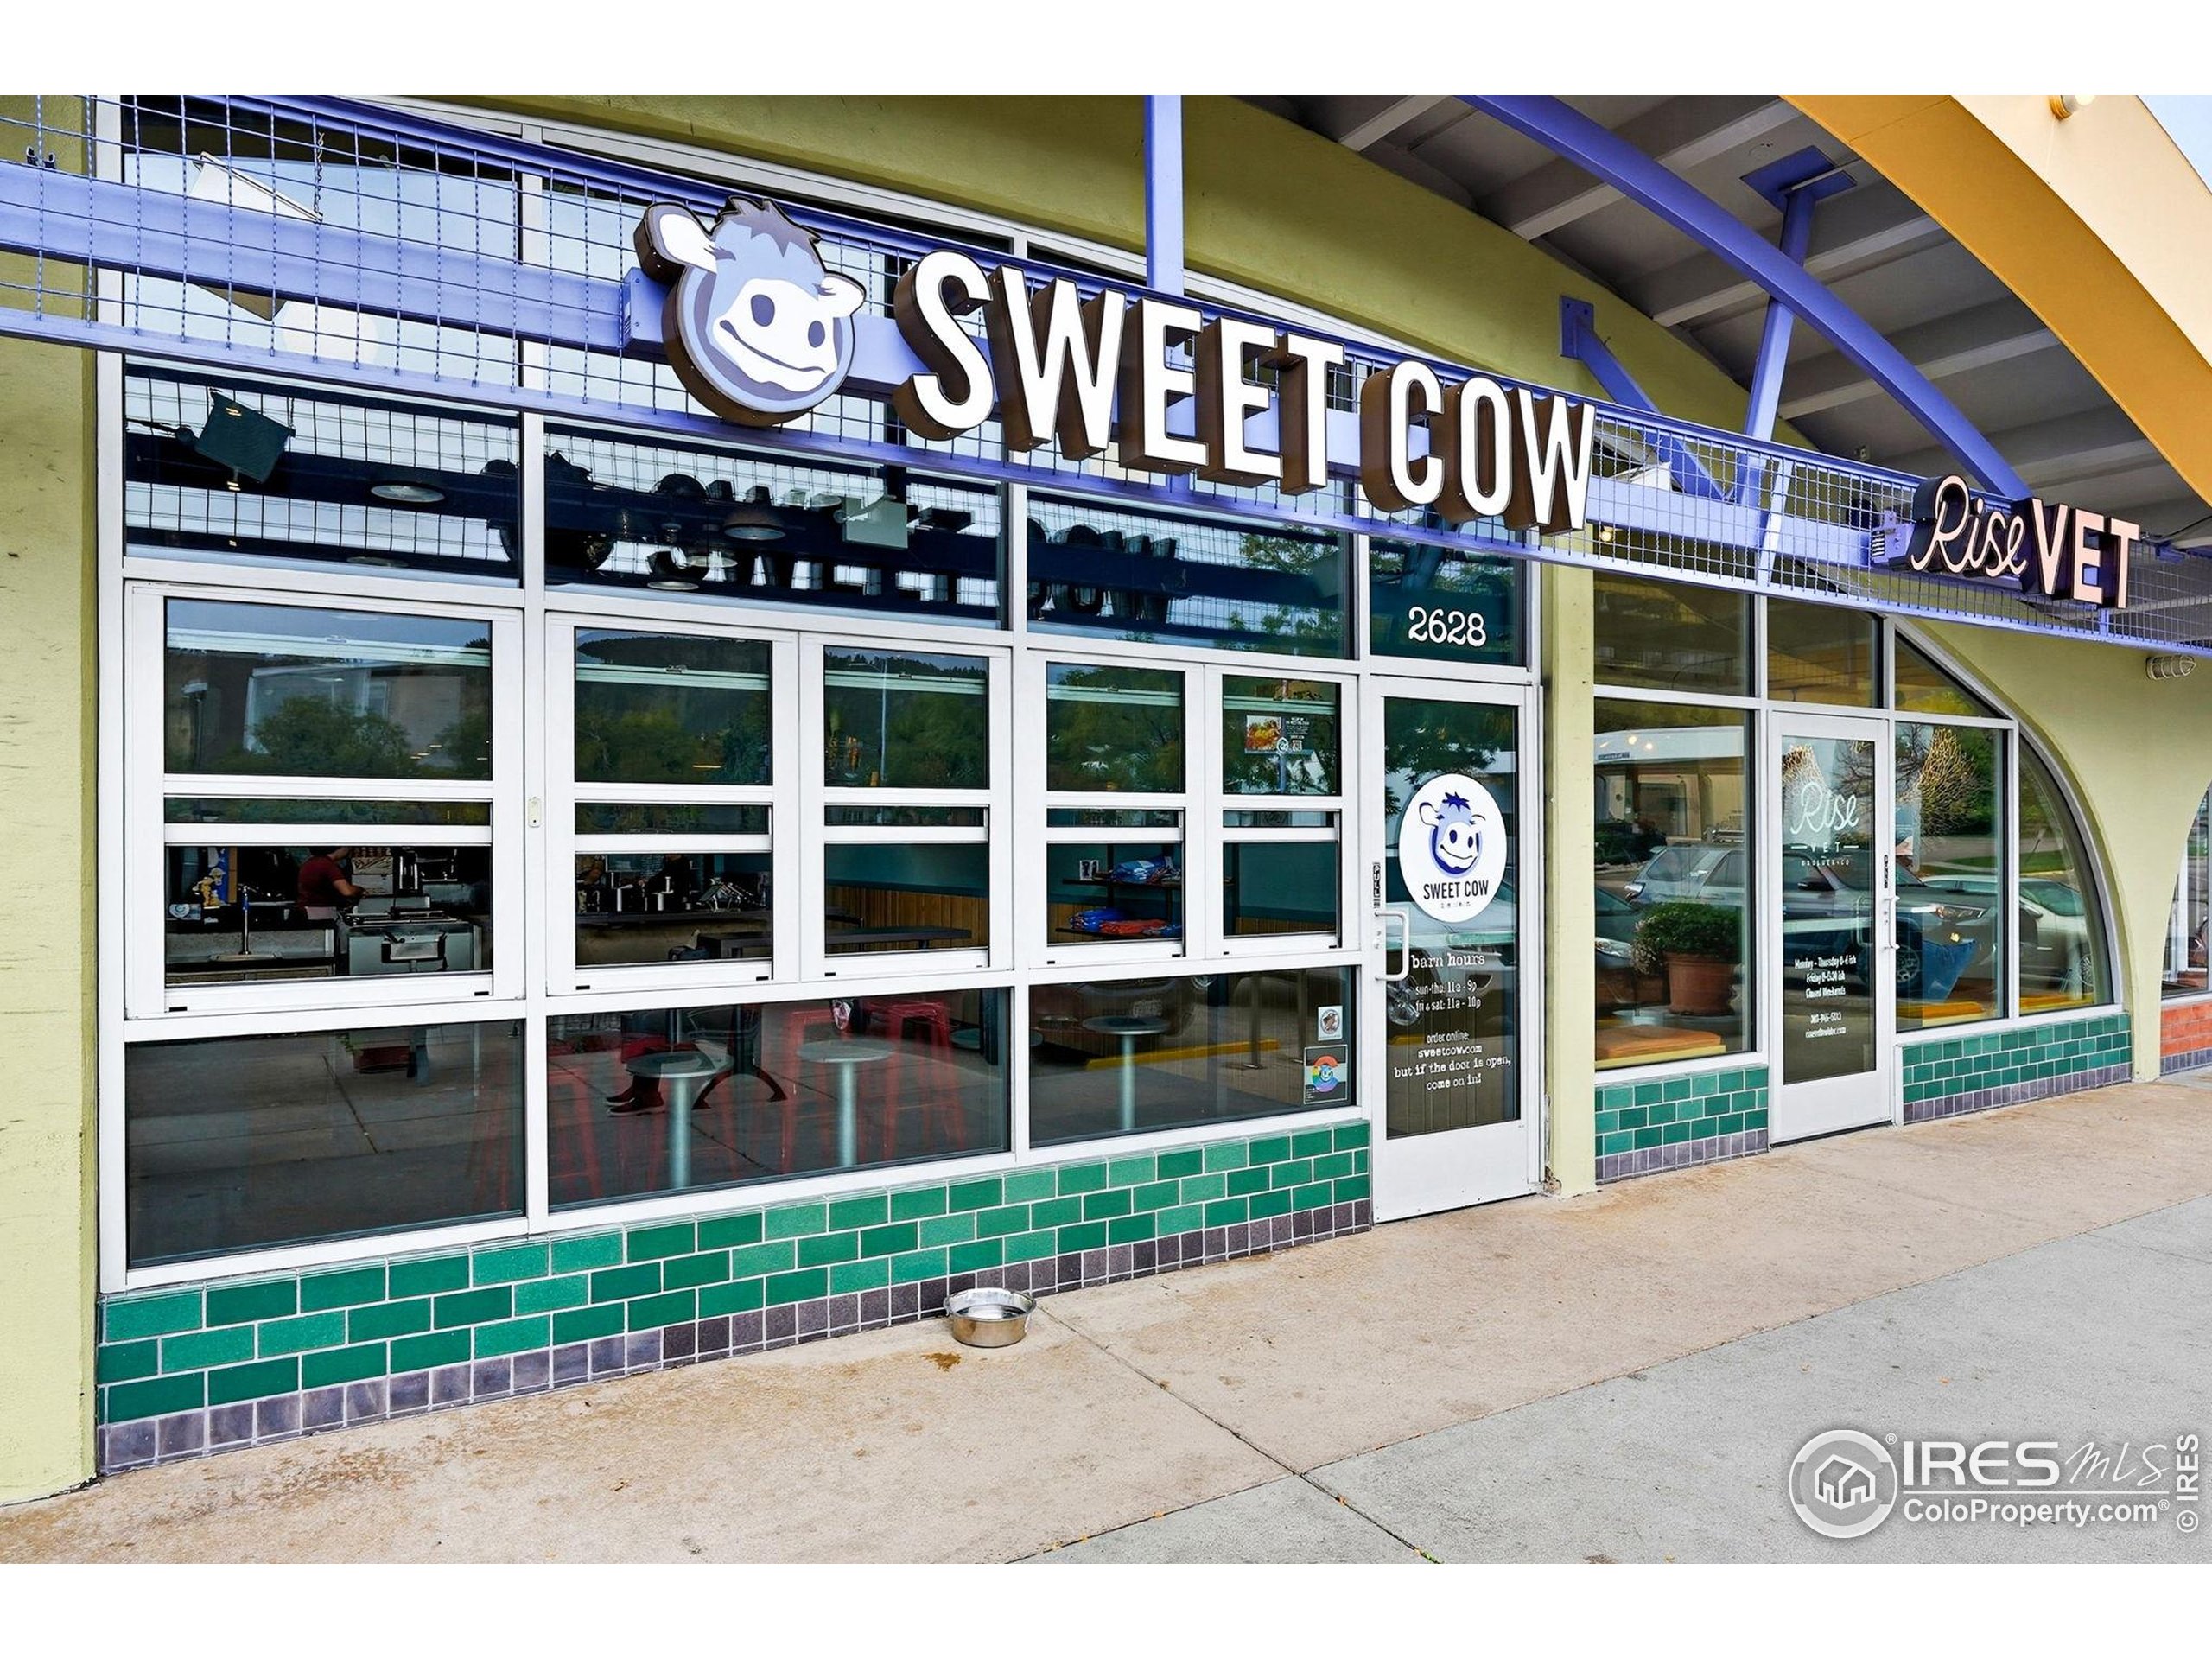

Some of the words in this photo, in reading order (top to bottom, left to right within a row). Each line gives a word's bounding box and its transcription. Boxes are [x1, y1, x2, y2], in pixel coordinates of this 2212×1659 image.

[910, 250, 1345, 488] SWEET
[1389, 359, 1597, 531] COW
[1910, 474, 2028, 578] Rise
[2031, 497, 2139, 608] VET
[1408, 606, 1486, 647] 2628
[1789, 781, 1859, 834] Rise
[1810, 842, 1840, 853] VET
[1423, 882, 1460, 899] SWEET
[1465, 880, 1489, 897] COW
[1411, 955, 1443, 968] barn
[1447, 953, 1485, 967] hours
[1415, 982, 1446, 995] sun-thu:
[1447, 981, 1461, 993] 11a
[1415, 999, 1425, 1012] fri
[1431, 1000, 1446, 1011] sat:
[1447, 997, 1460, 1009] 11a
[1468, 995, 1482, 1009] 10p
[1426, 1033, 1445, 1044] order
[1418, 1045, 1483, 1058] sweetcow.com
[1394, 1066, 1413, 1078] but
[1415, 1064, 1427, 1076] if
[1428, 1062, 1446, 1073] the
[1449, 1059, 1470, 1072] door
[1473, 1057, 1484, 1068] is
[1485, 1055, 1511, 1069] open,
[1427, 1078, 1451, 1091] come
[1452, 1077, 1465, 1086] on
[1466, 1073, 1482, 1084] in!
